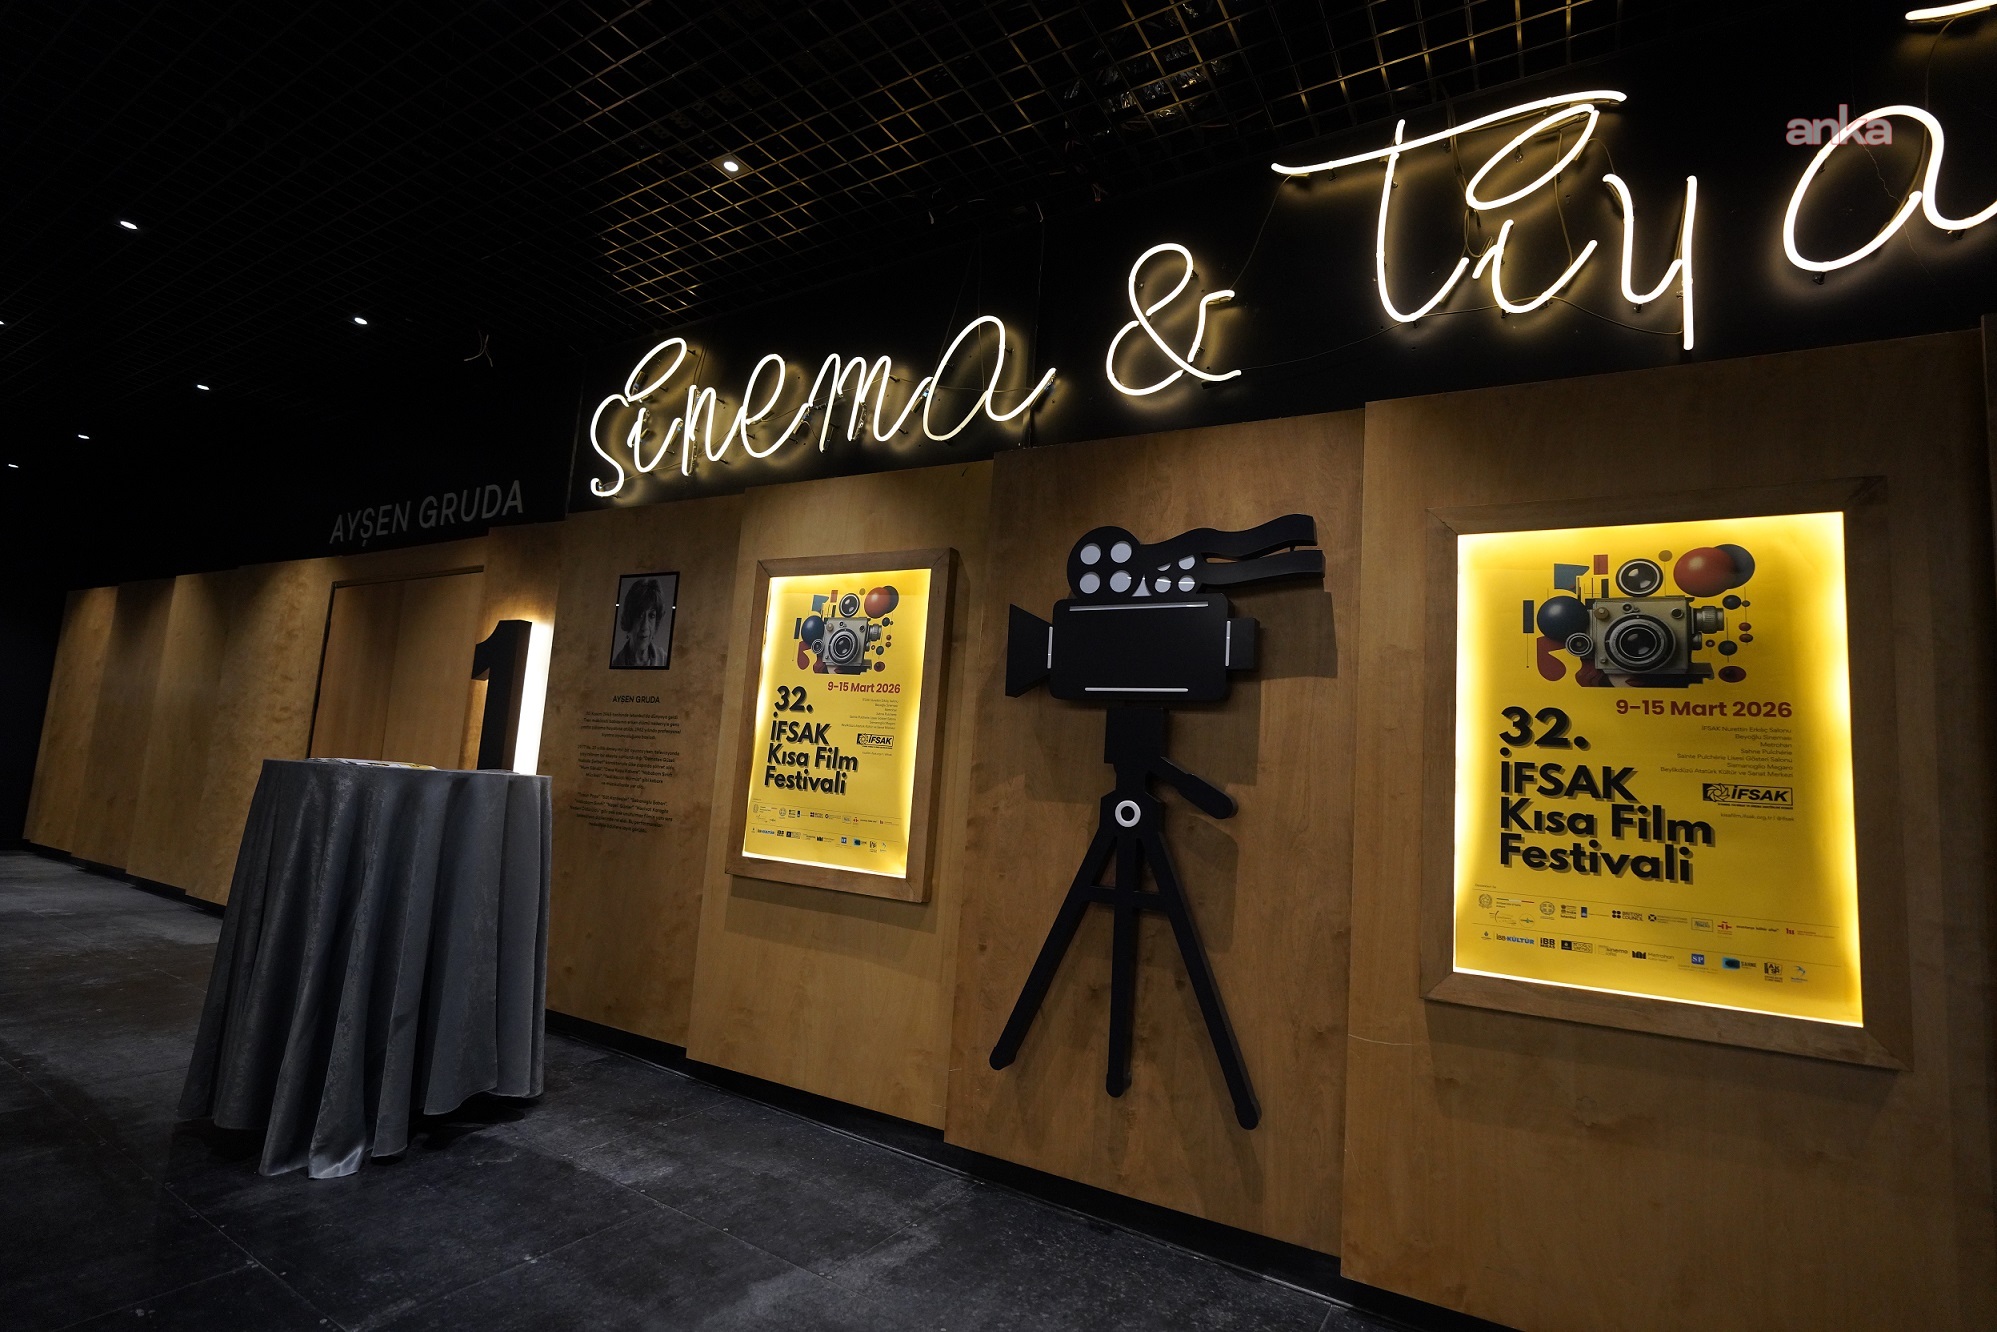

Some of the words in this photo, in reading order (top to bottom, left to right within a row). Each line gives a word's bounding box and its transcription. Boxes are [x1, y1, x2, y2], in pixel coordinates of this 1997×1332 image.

[329, 500, 411, 547] AYŞEN
[418, 479, 524, 529] GRUDA
[635, 695, 660, 704] GRUDA
[774, 685, 814, 713] 32.
[827, 681, 849, 692] 9-15
[850, 682, 875, 693] Mart
[876, 683, 900, 694] 2026
[1616, 699, 1665, 717] 9-15
[1670, 700, 1728, 717] Mart
[1732, 701, 1793, 718] 2026
[770, 711, 831, 746] İFSAK
[1499, 706, 1591, 751] 32.
[767, 743, 810, 767] Kısa
[814, 746, 858, 771] Film
[764, 765, 848, 795] Festivali
[1499, 746, 1645, 802] İFSAK
[1731, 784, 1789, 802] İFSAK
[1500, 796, 1597, 839] Kısa
[1611, 803, 1715, 849] Film
[1500, 832, 1696, 884] Festivali
